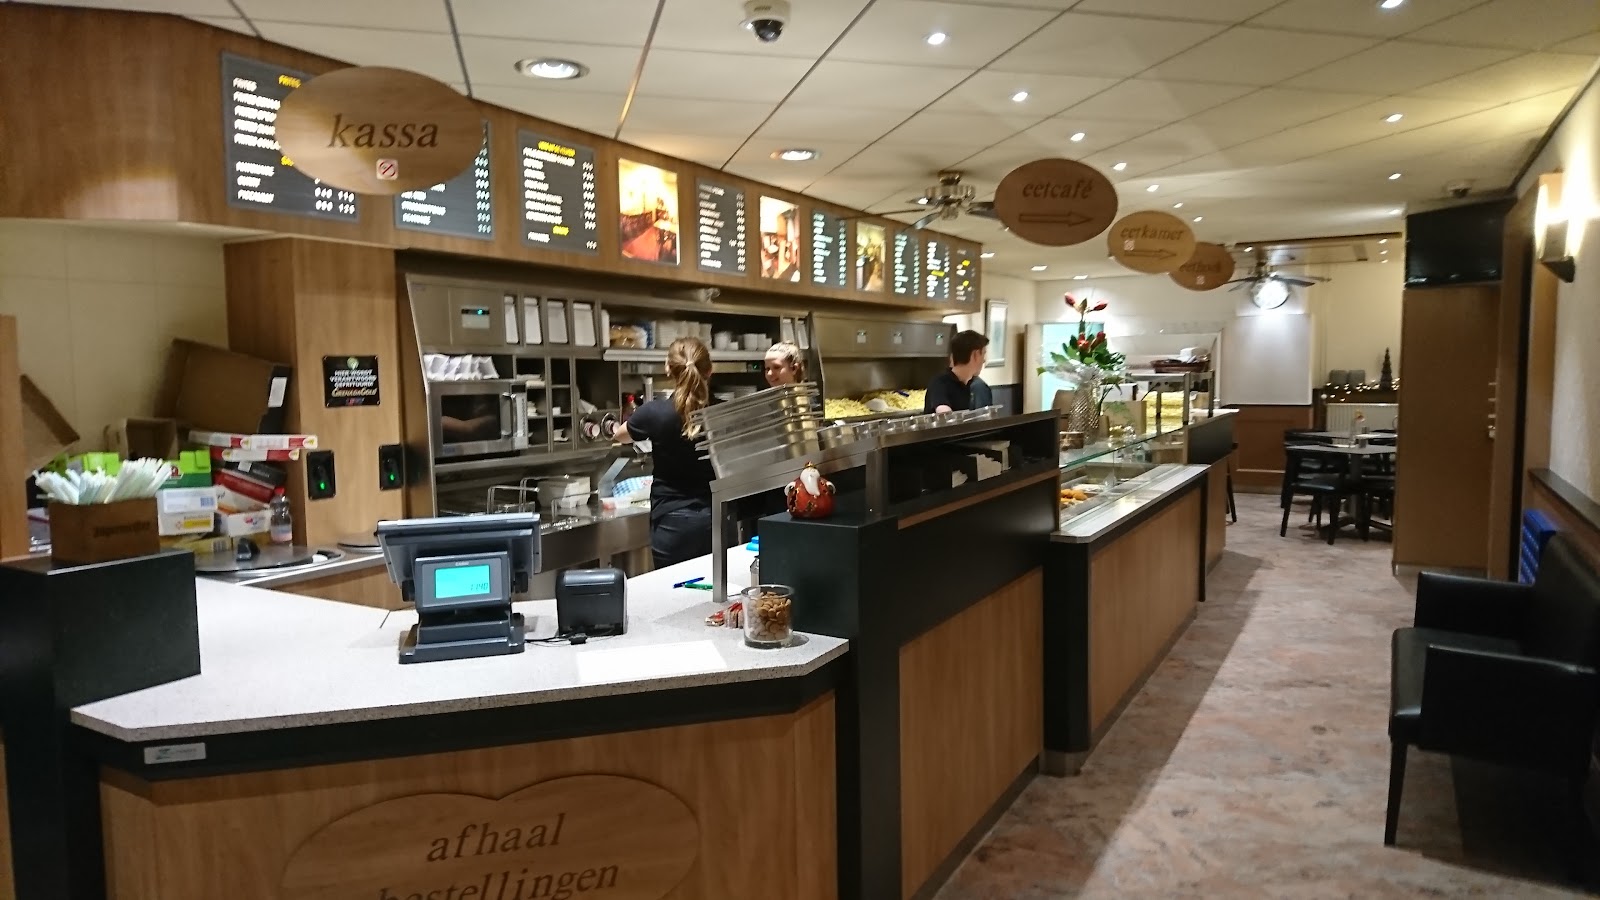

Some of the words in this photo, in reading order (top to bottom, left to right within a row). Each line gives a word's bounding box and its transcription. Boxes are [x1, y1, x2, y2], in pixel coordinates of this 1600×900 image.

[327, 113, 439, 149] kassa
[1021, 179, 1095, 200] eetcafé
[1120, 224, 1185, 241] eetkamer
[426, 812, 566, 864] afhaal
